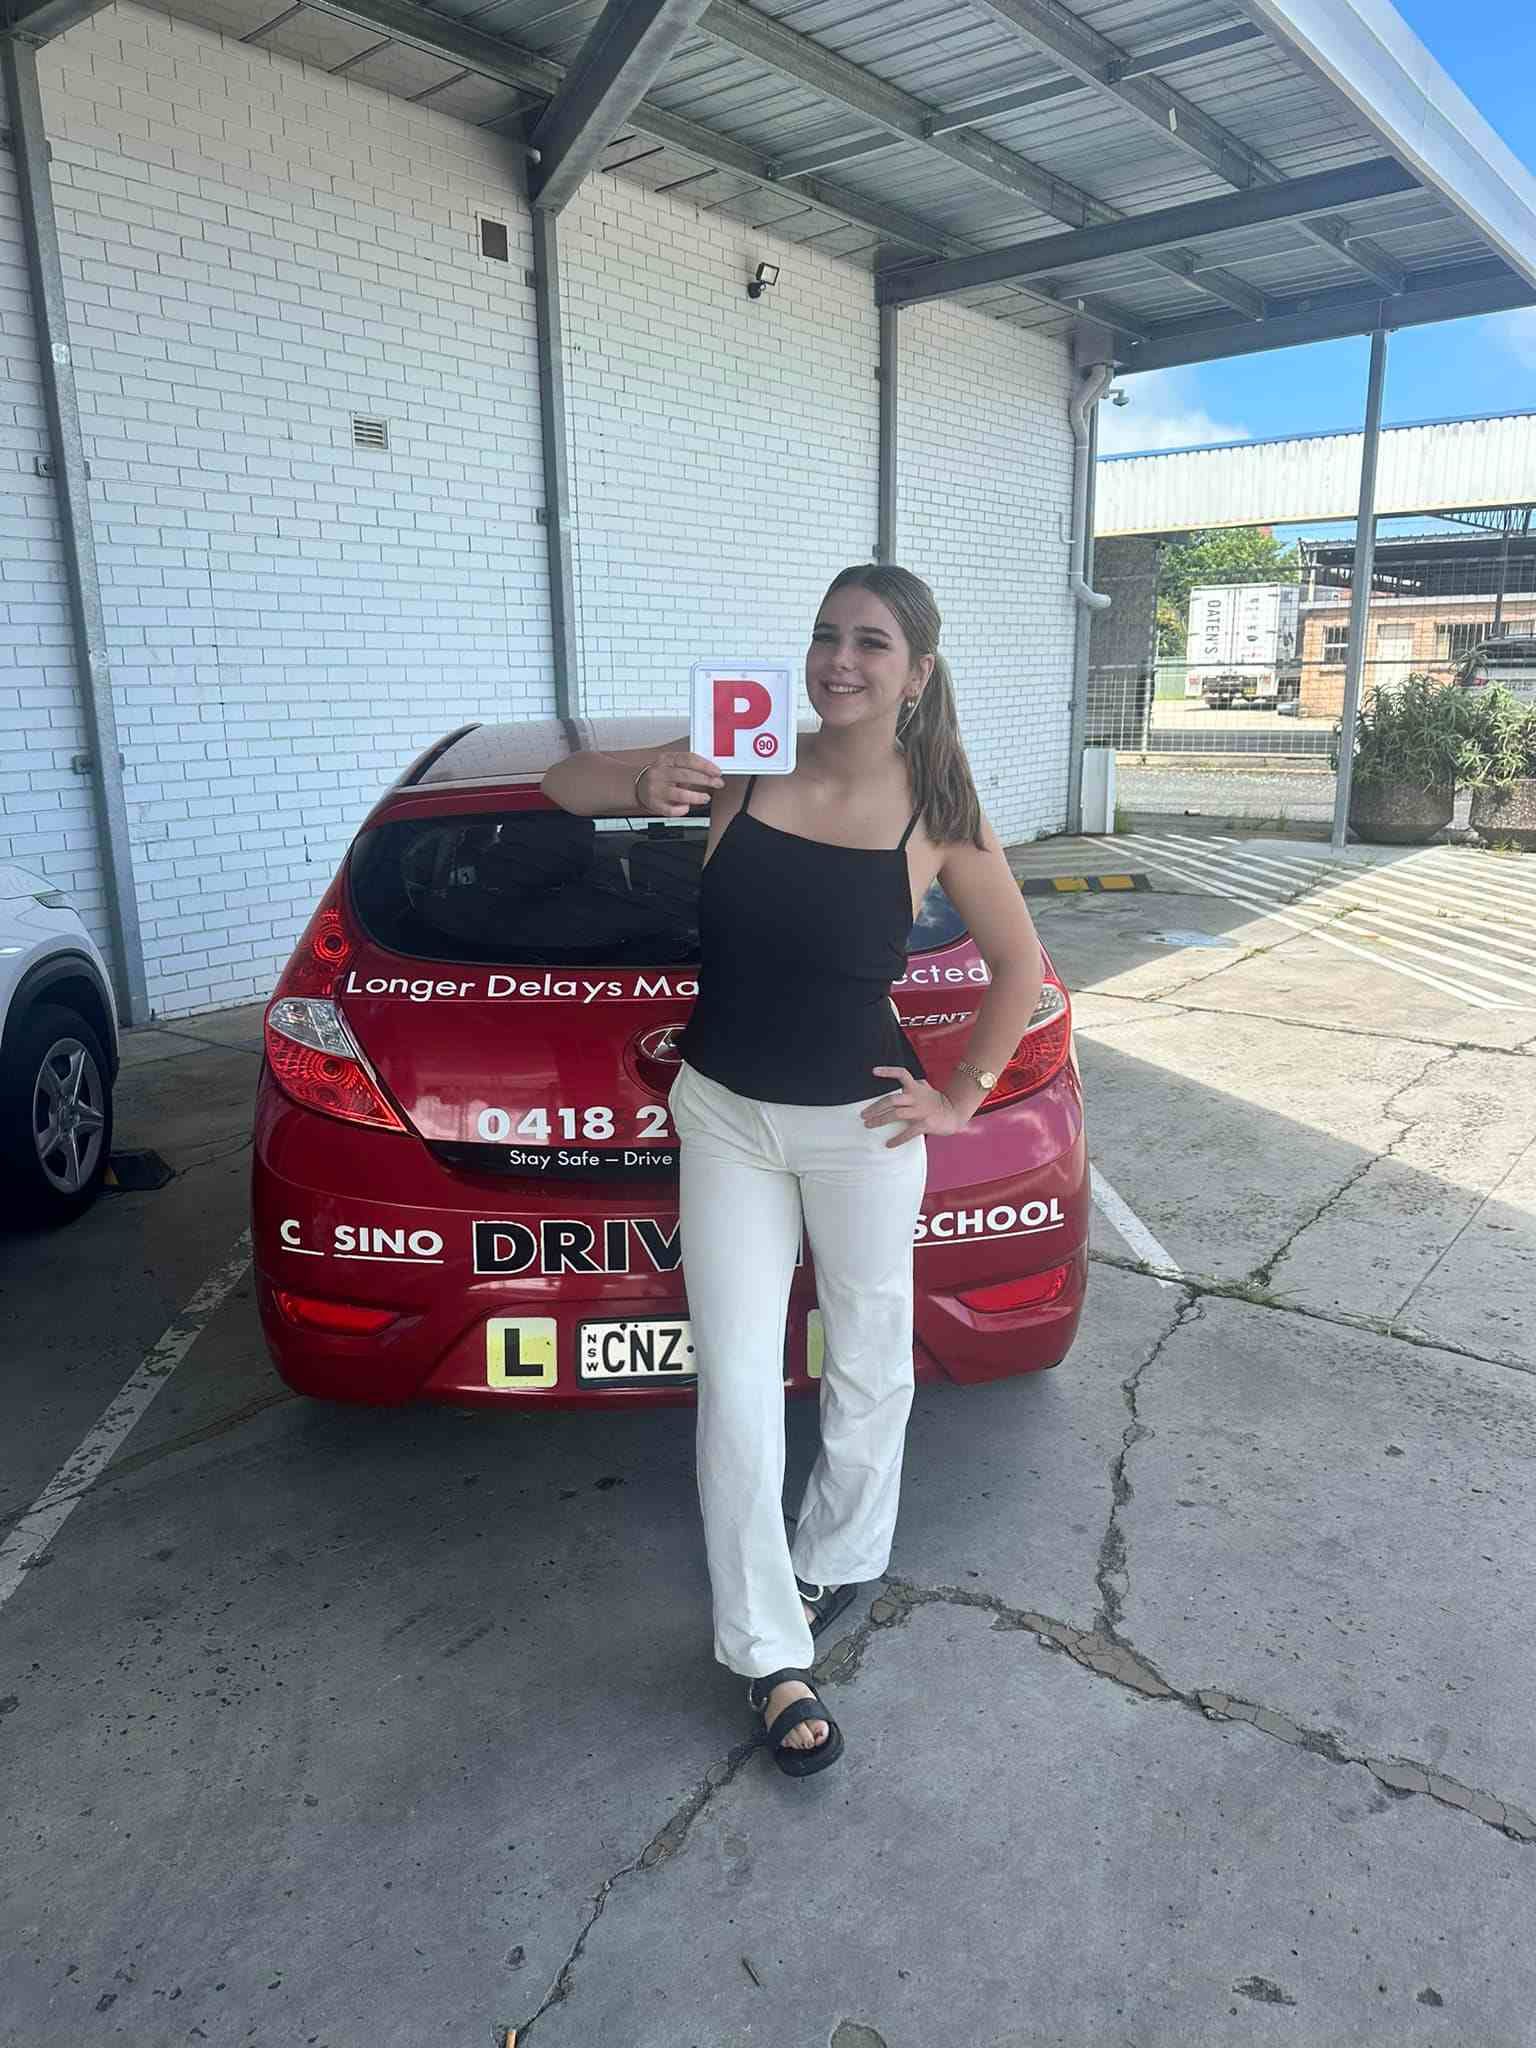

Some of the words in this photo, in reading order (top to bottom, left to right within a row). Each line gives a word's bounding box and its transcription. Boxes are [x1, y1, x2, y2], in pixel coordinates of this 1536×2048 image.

[713, 680, 771, 757] P
[758, 740, 773, 751] 90
[346, 971, 476, 1002] Longer
[487, 973, 623, 1004] Delays
[632, 975, 699, 998] Ma
[899, 1011, 973, 1027] CCENT
[478, 1106, 615, 1141] 0418
[510, 1150, 551, 1169] Stay
[557, 1150, 600, 1166] Safe
[624, 1151, 673, 1166] Drive
[472, 1219, 682, 1274] DRIV
[913, 1198, 1065, 1241] SCHOOL
[504, 1328, 544, 1377] L
[586, 1334, 599, 1372] NSW
[602, 1328, 683, 1373] CNZ
